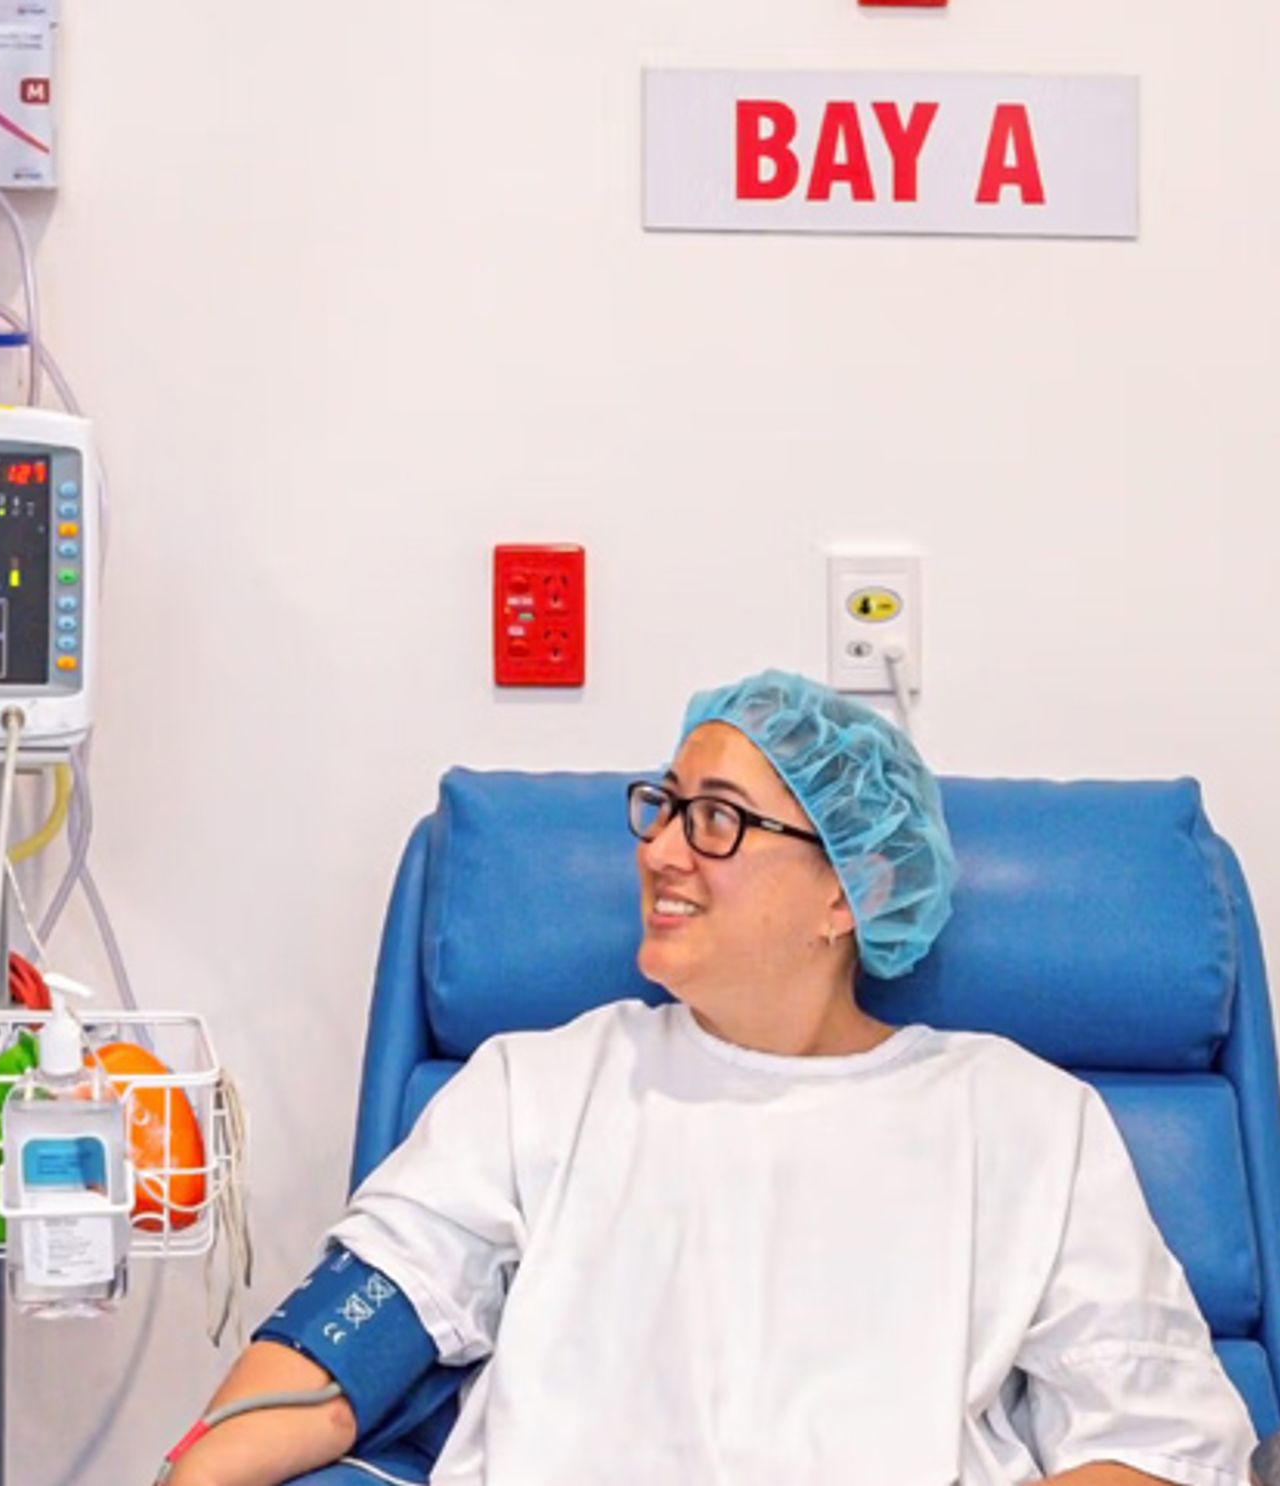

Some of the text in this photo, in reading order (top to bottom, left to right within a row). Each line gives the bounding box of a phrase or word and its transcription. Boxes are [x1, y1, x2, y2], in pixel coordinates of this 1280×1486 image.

[26, 82, 45, 101] M
[736, 99, 1046, 205] BAY A
